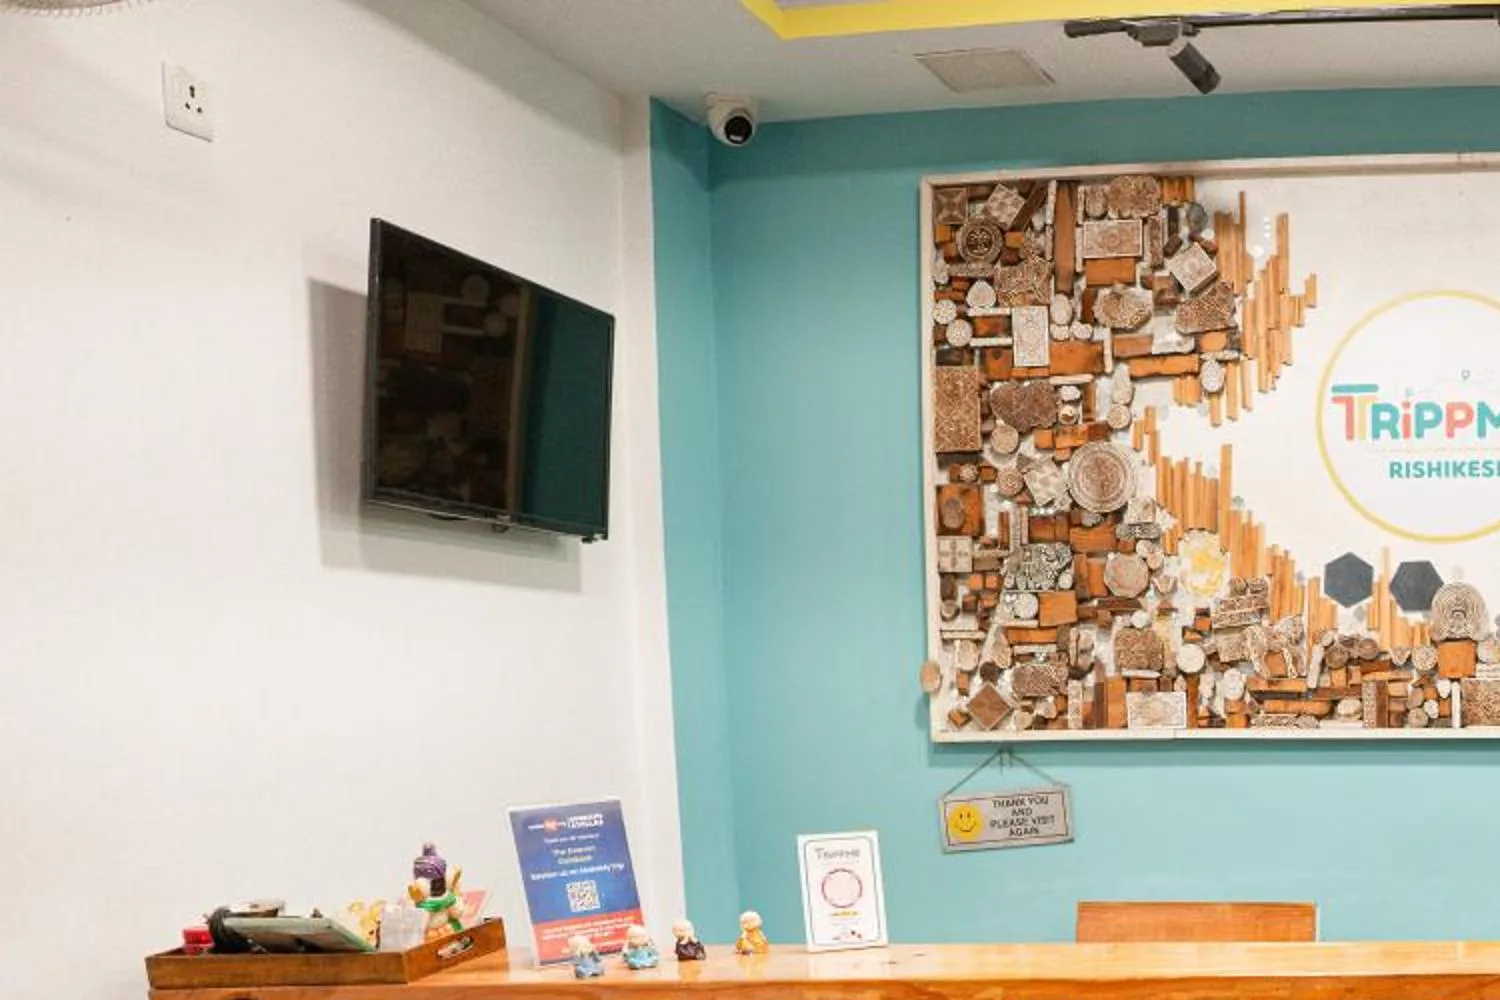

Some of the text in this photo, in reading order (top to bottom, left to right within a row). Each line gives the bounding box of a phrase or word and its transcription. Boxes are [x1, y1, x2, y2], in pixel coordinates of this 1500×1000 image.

[992, 795, 1049, 808] THANK YOU
[1011, 807, 1033, 817] AND
[989, 815, 1055, 829] PLEASE VISIT
[1009, 827, 1040, 837] AGAIN
